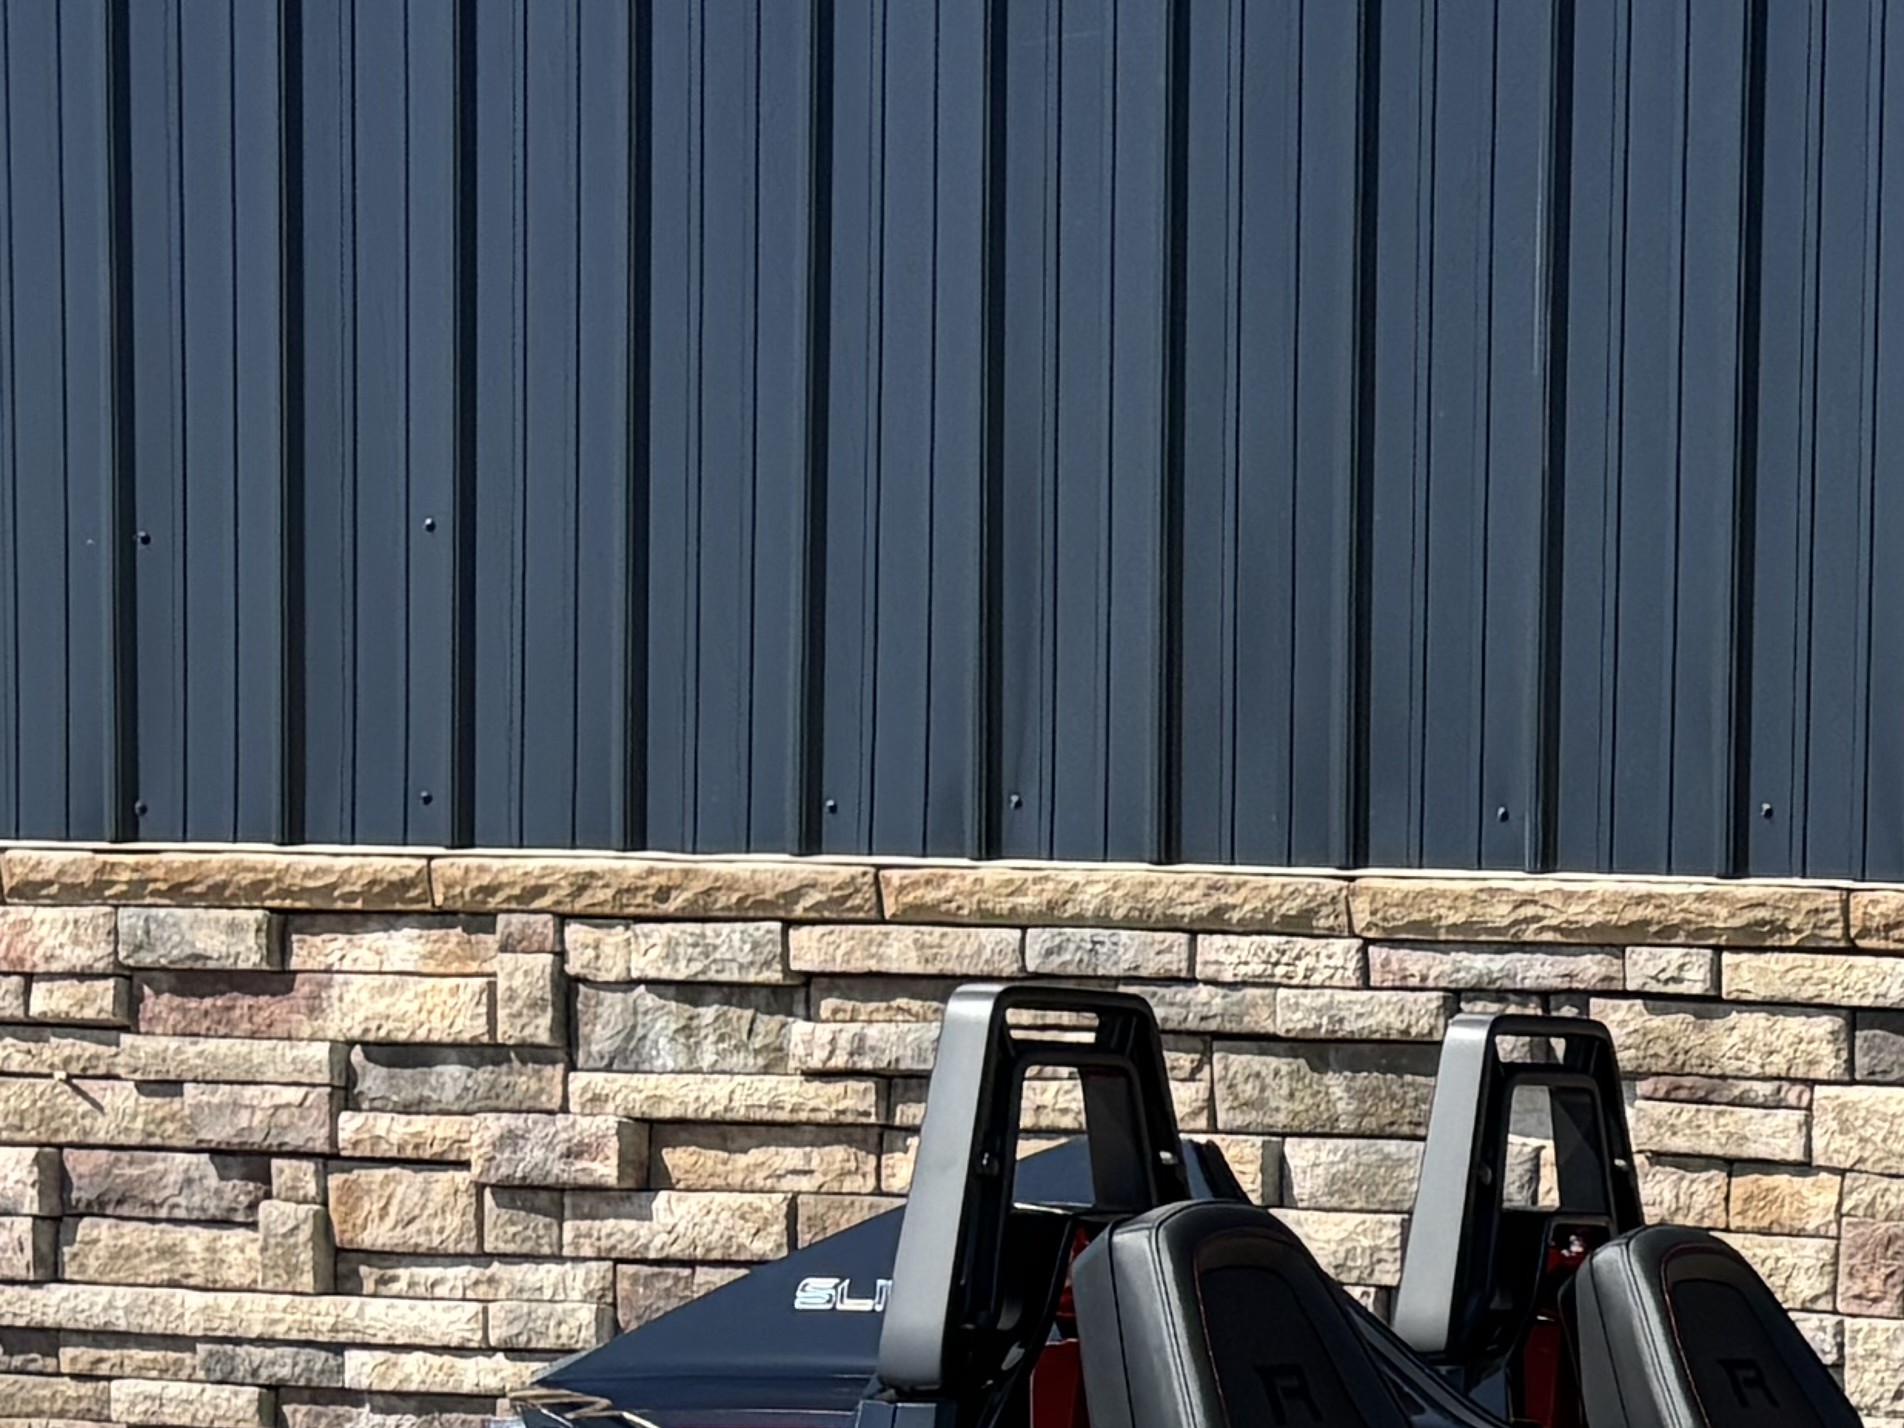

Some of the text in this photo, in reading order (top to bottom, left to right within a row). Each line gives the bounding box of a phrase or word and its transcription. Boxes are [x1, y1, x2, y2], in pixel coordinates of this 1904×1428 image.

[794, 1277, 893, 1312] SLI
[1253, 1363, 1323, 1426] R
[1717, 1358, 1780, 1409] R
